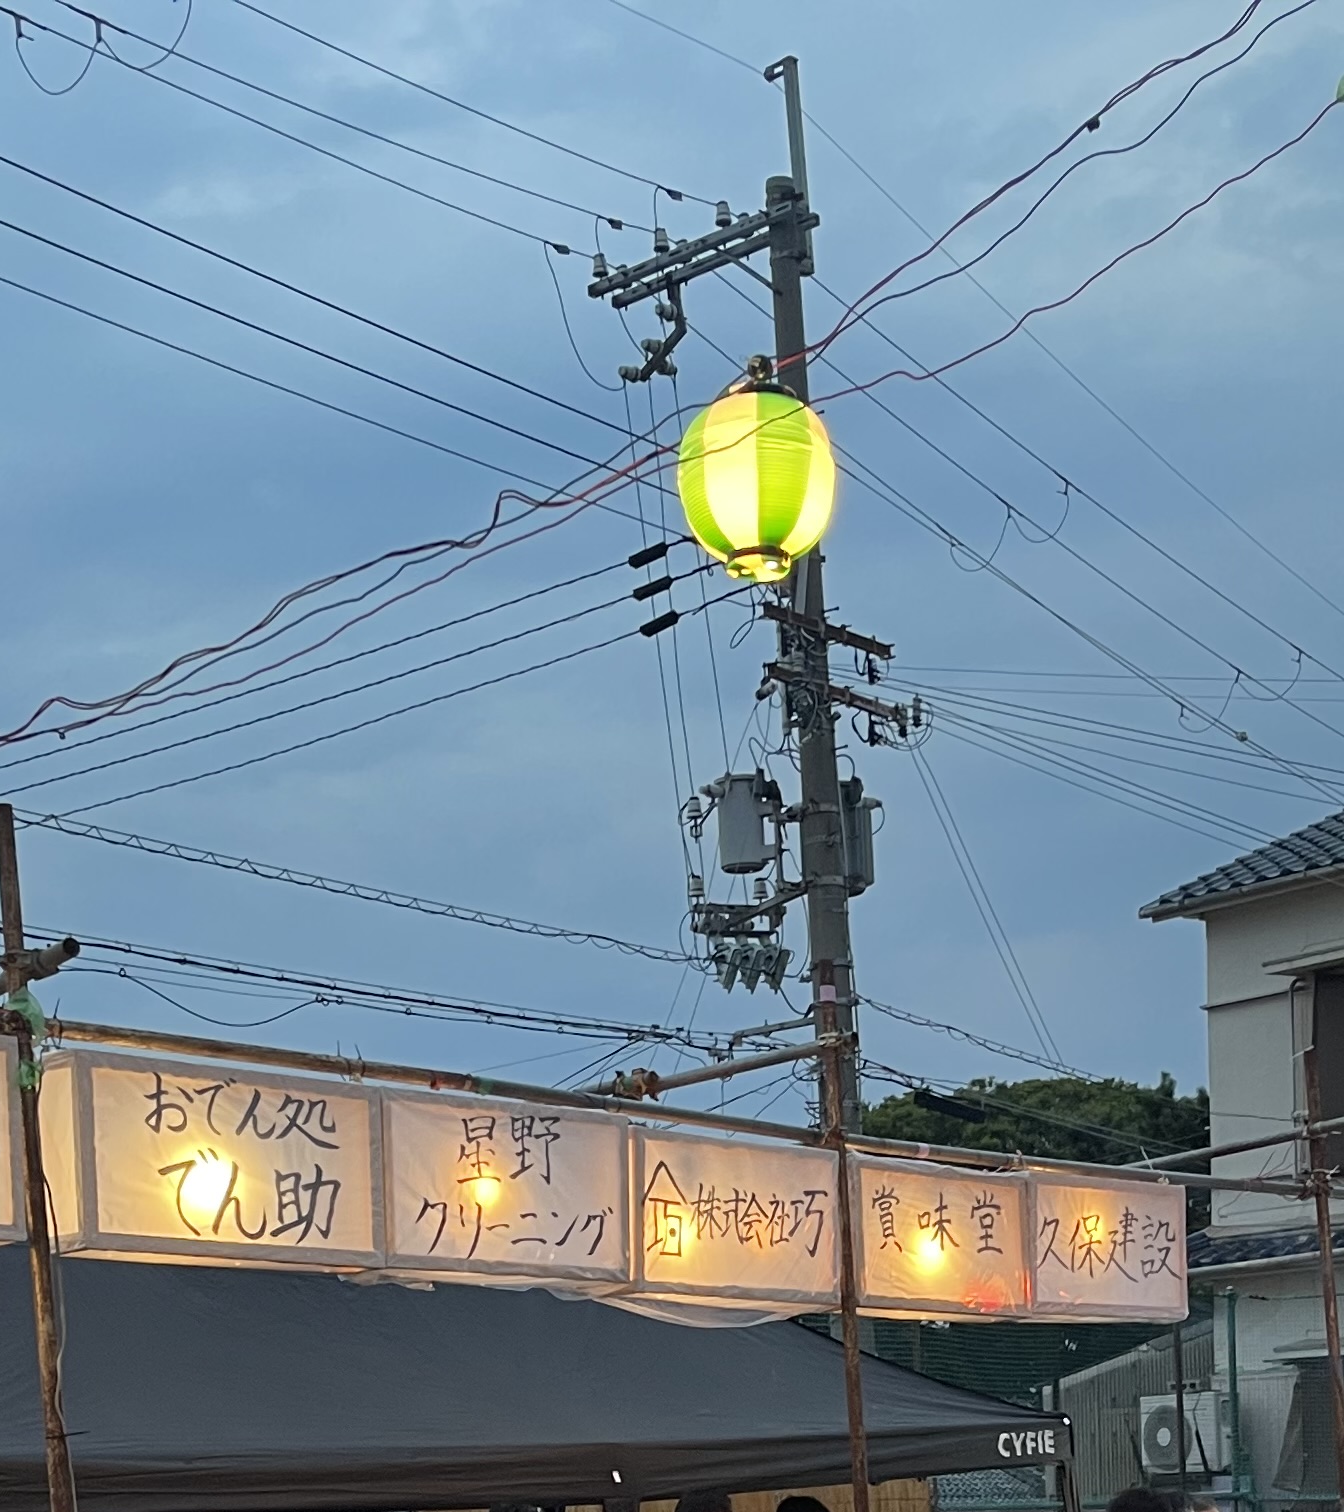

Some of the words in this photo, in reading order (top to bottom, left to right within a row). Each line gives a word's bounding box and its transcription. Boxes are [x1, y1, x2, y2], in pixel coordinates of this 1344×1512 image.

[143, 1071, 341, 1150] おでん処
[457, 1115, 561, 1185] 星野
[158, 1147, 342, 1245] でん助
[415, 1197, 614, 1259] クリーニング
[689, 1182, 829, 1258] 株式会社巧
[1036, 1205, 1184, 1283] 久保建設
[997, 1429, 1055, 1458] CYFIE
